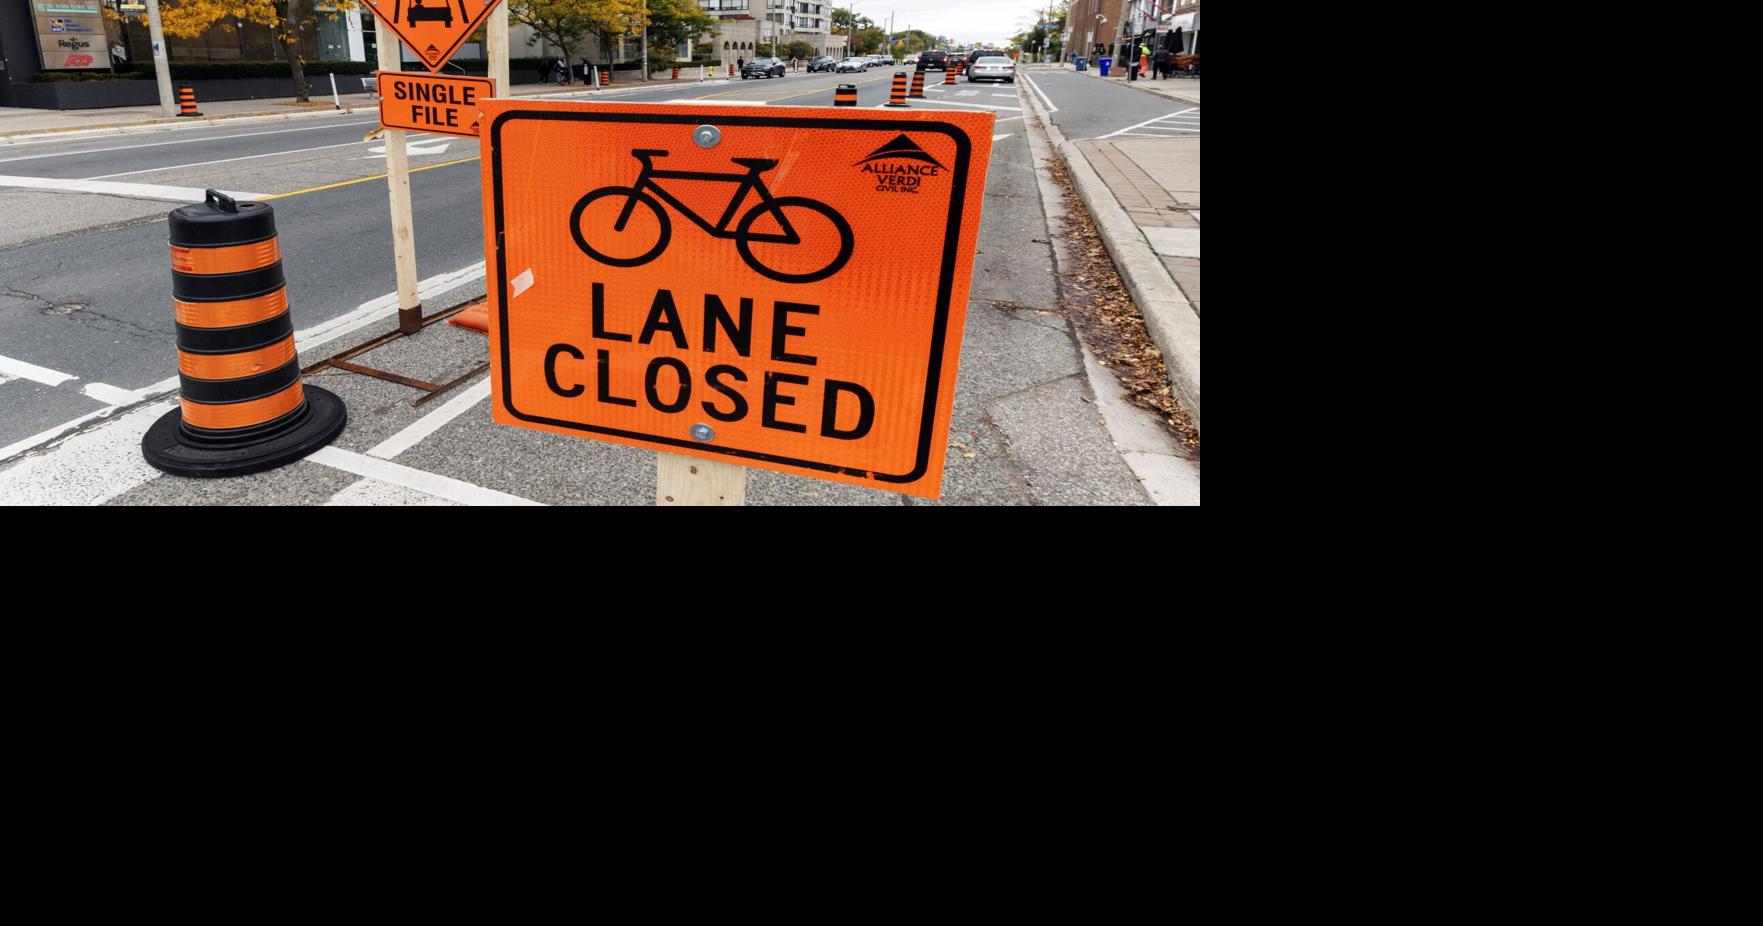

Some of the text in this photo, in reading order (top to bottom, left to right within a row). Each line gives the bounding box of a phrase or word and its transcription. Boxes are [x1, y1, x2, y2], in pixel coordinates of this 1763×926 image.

[58, 39, 90, 50] Regus
[394, 81, 476, 106] SINGLE
[412, 105, 458, 127] FILE
[861, 163, 939, 176] ALLIANCE
[877, 175, 921, 187] VERDI
[592, 282, 820, 365] LANE
[544, 343, 875, 440] CLOSED
